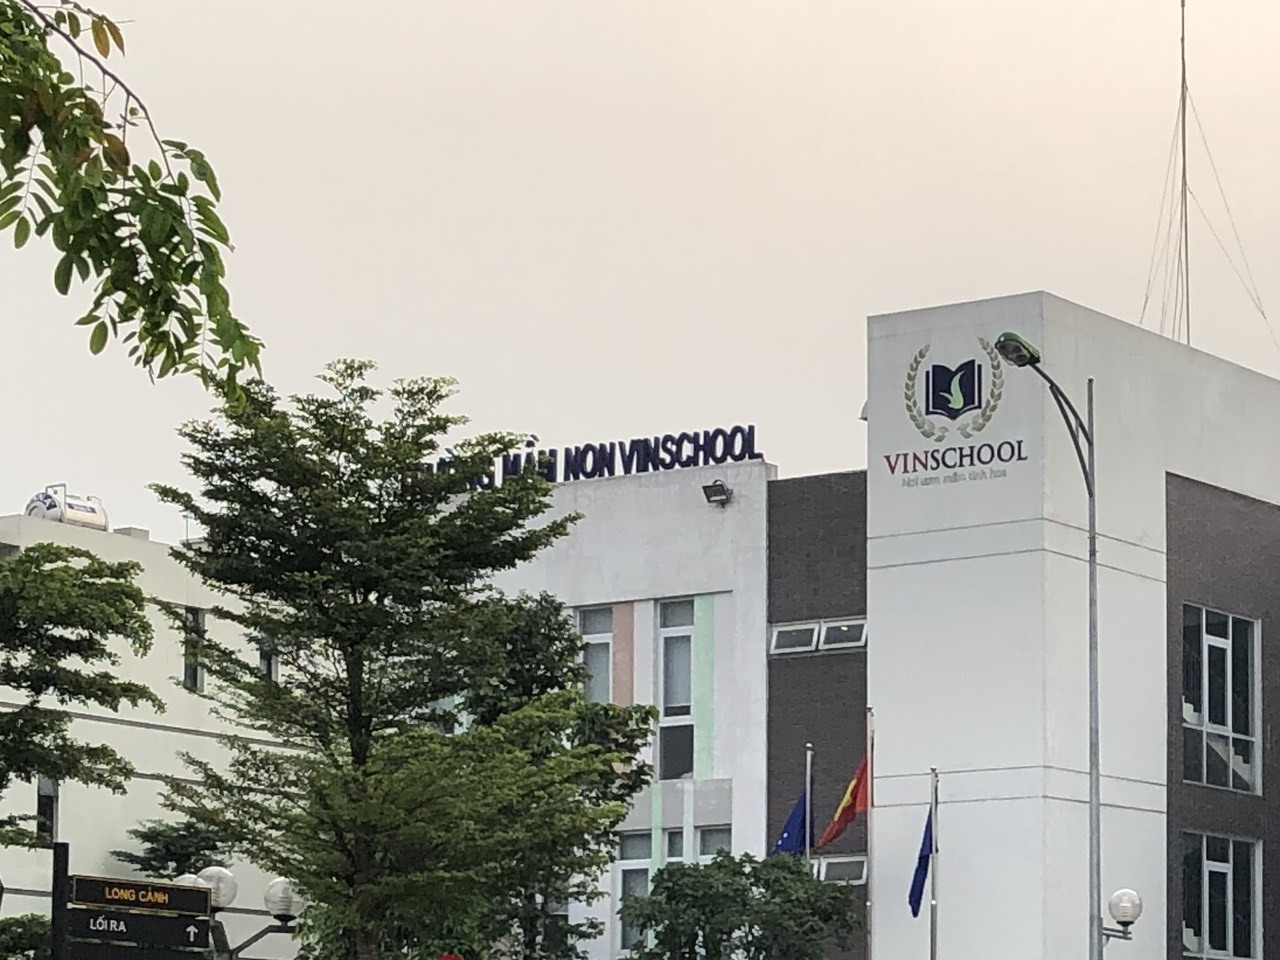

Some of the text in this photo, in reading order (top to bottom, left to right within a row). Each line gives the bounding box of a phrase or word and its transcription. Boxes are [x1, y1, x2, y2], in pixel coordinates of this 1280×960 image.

[563, 443, 616, 482] NON
[618, 424, 764, 475] VINSCHOOL
[884, 440, 1028, 475] VINSCHOOL
[105, 886, 169, 904] LONG CẢNH
[90, 914, 127, 933] LỐI RA
